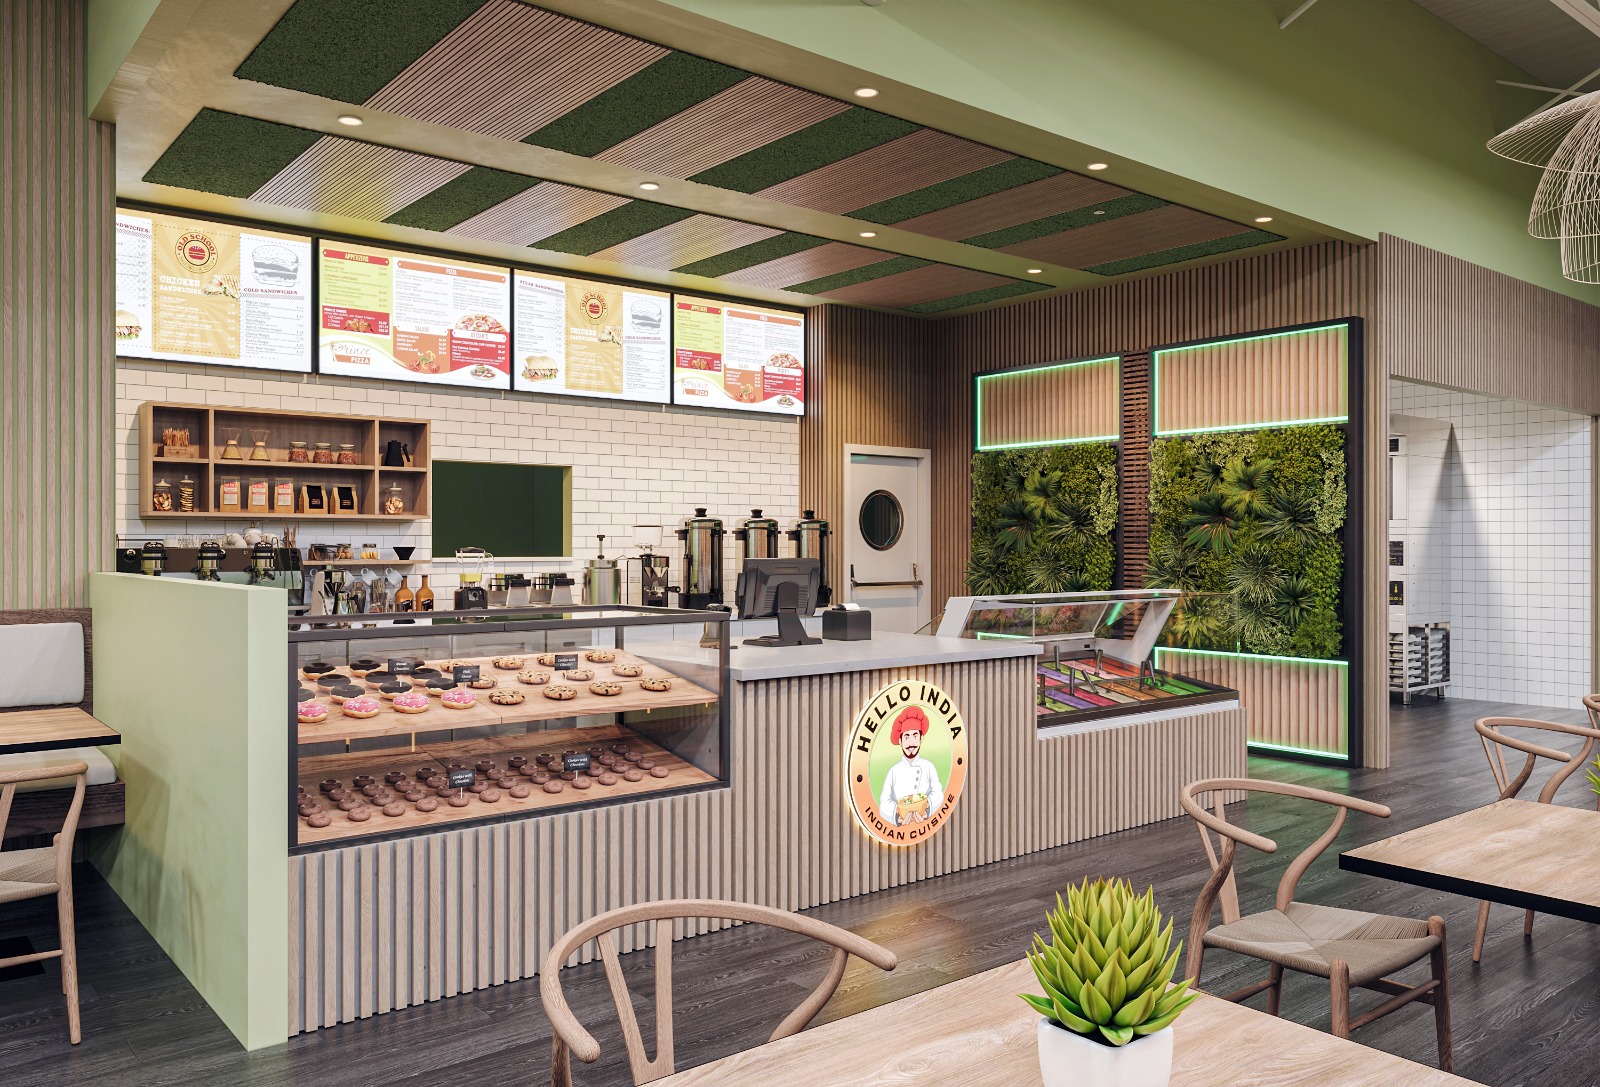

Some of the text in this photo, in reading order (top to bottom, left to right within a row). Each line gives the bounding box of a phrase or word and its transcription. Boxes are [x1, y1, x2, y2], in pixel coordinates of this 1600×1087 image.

[177, 234, 217, 256] OLD SCHOOL
[160, 276, 201, 287] CHICKEN
[160, 285, 203, 295] SANDWICHES
[351, 356, 370, 364] PIZZA
[857, 685, 962, 753] HELLO INDIA
[865, 793, 955, 840] INDIAN CUISINE
